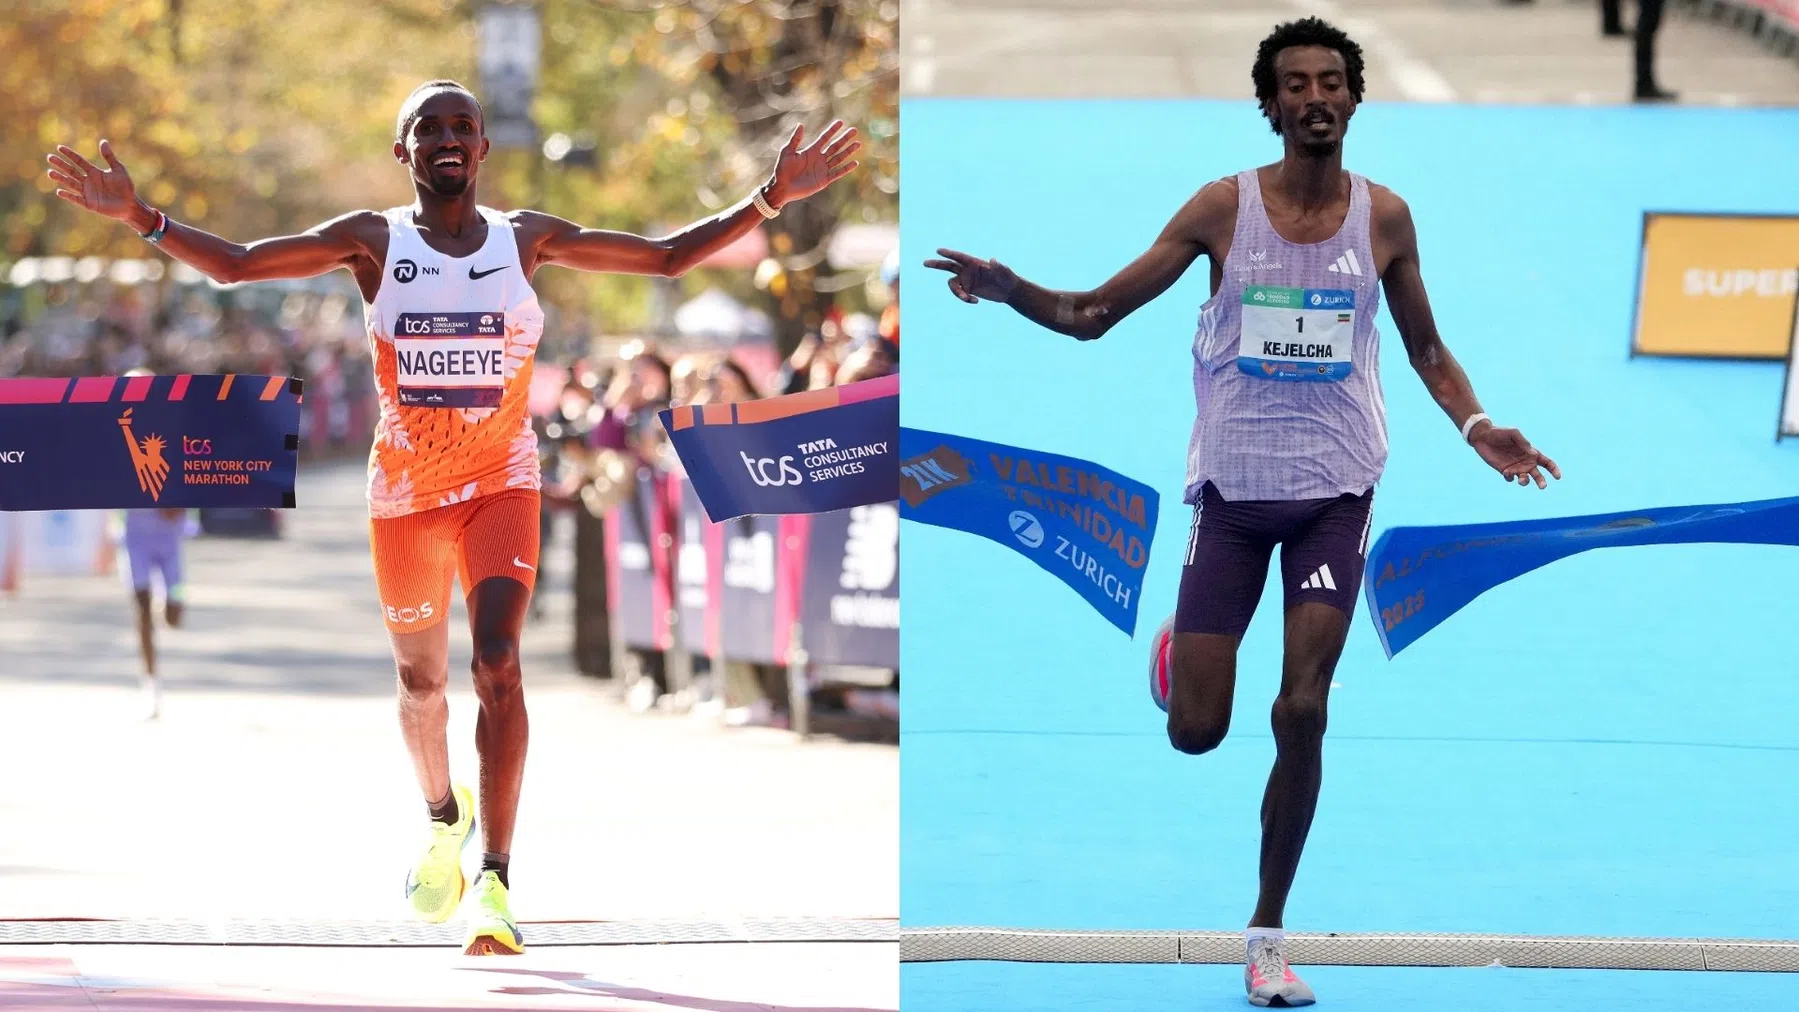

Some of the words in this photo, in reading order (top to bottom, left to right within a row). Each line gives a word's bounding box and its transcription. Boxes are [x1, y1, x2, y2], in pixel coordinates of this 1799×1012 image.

[422, 267, 440, 275] NN
[1324, 296, 1351, 304] ZURICH
[405, 317, 430, 333] tcs
[1295, 316, 1304, 333] 1
[1263, 341, 1333, 358] KEJELCHA
[398, 350, 503, 376] NAGEEYE
[183, 435, 212, 455] tcs
[798, 437, 838, 455] TATA
[803, 441, 889, 469] CONSULTANCY
[183, 460, 212, 471] NEW
[214, 460, 244, 471] YORK
[246, 460, 272, 471] CITY
[739, 450, 803, 487] tcs
[809, 461, 865, 483] SERVICES
[900, 457, 960, 492] 21K
[184, 474, 249, 485] MARATHON
[989, 452, 1147, 530] VALENCIA
[1053, 535, 1131, 610] ZURICH
[1381, 588, 1425, 633] 2025
